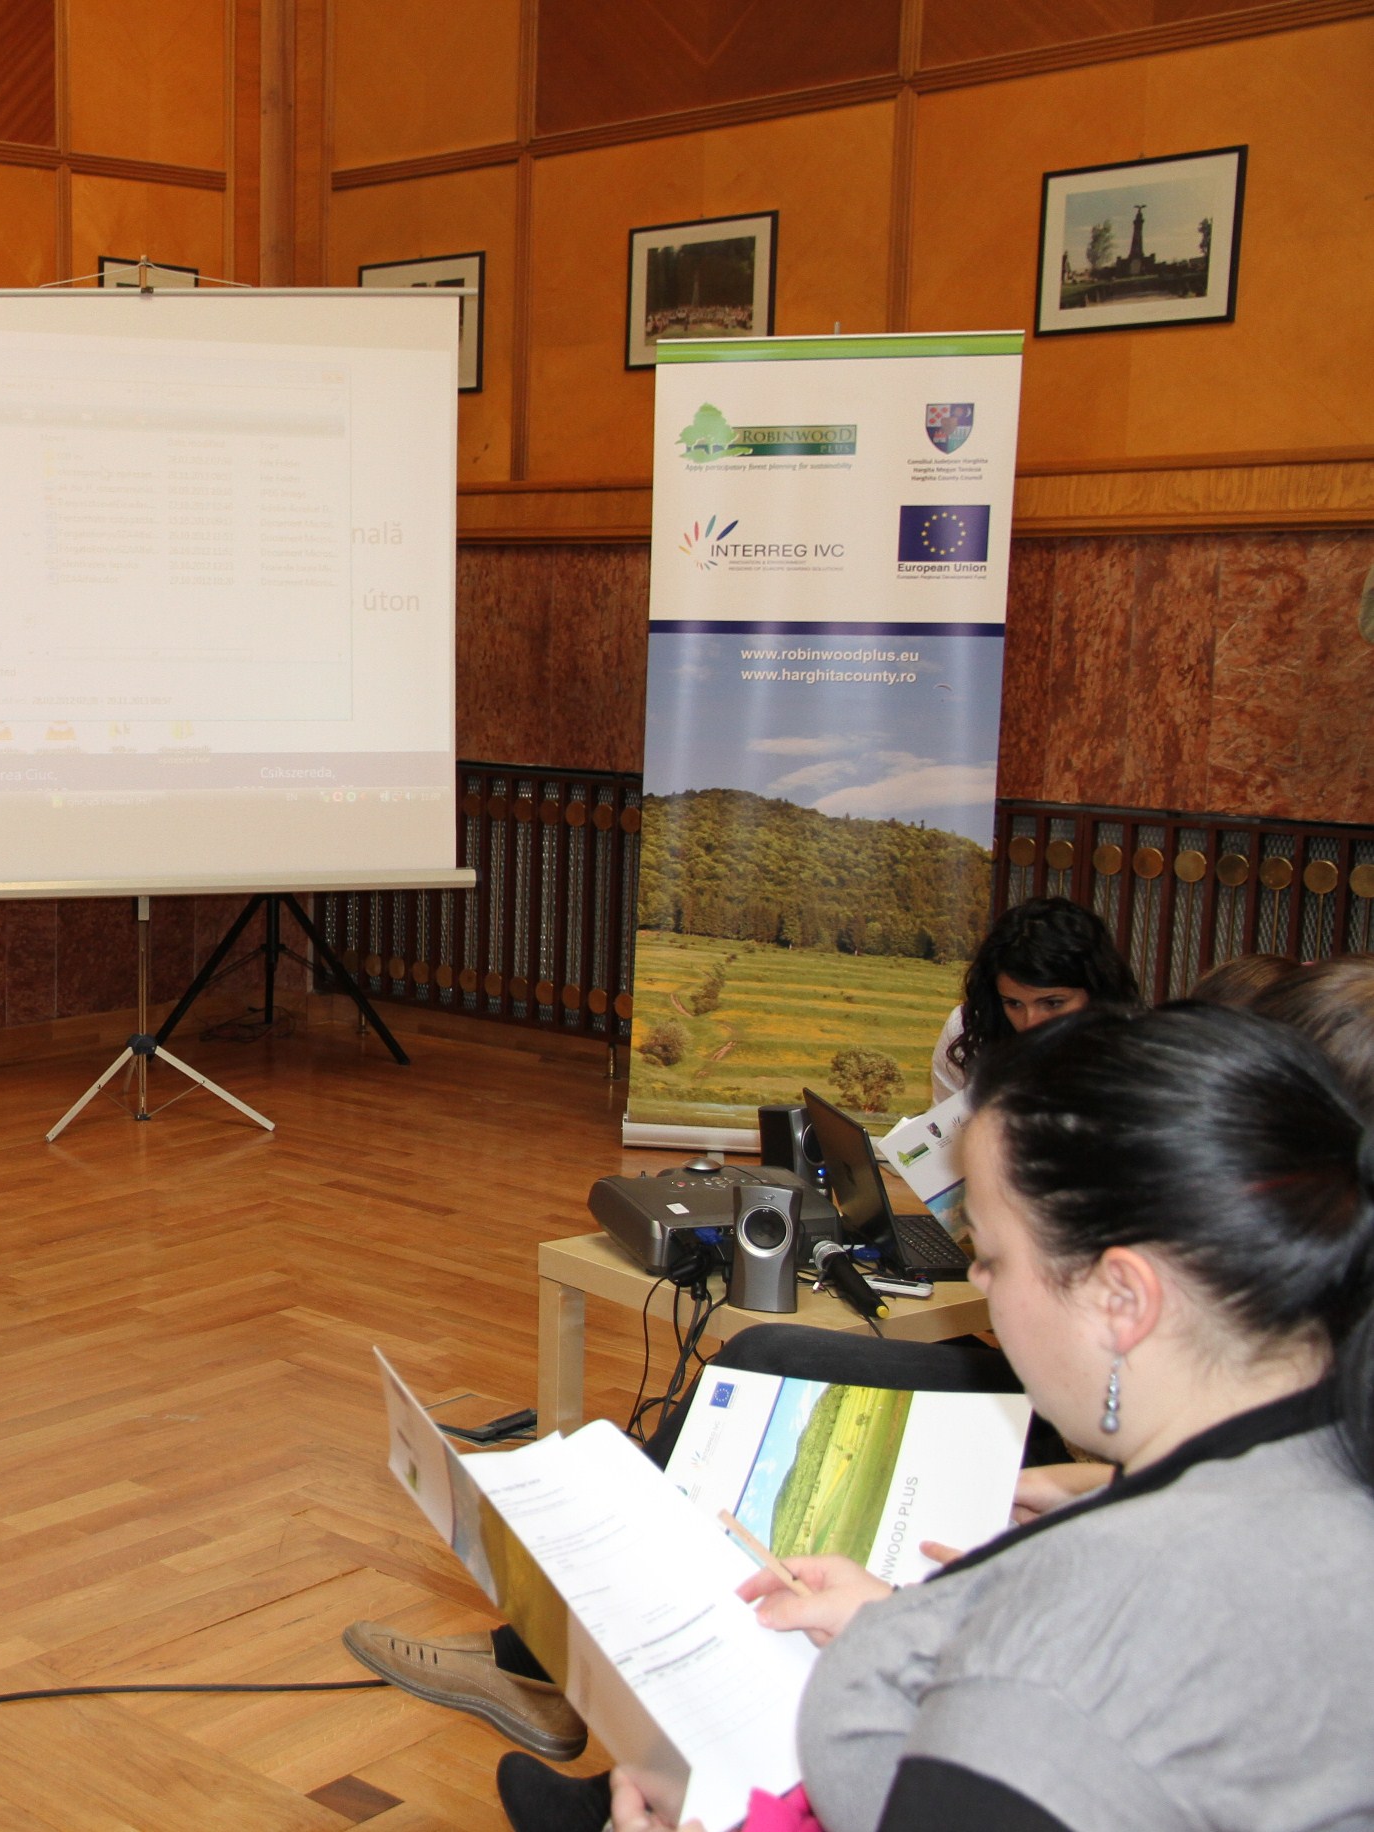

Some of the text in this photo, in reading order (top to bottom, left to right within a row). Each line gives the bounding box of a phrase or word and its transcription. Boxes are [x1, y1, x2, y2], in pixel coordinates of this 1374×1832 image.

[742, 429, 852, 443] ROBINWOOD
[819, 445, 851, 454] PLUS
[711, 544, 845, 558] INTERREG IVC
[898, 563, 987, 574] European Union
[363, 588, 420, 612] úton
[741, 648, 920, 663] www.robinwoodplus.eu
[741, 668, 917, 686] www.harghitacounty.ro
[898, 1475, 919, 1517] PLUS
